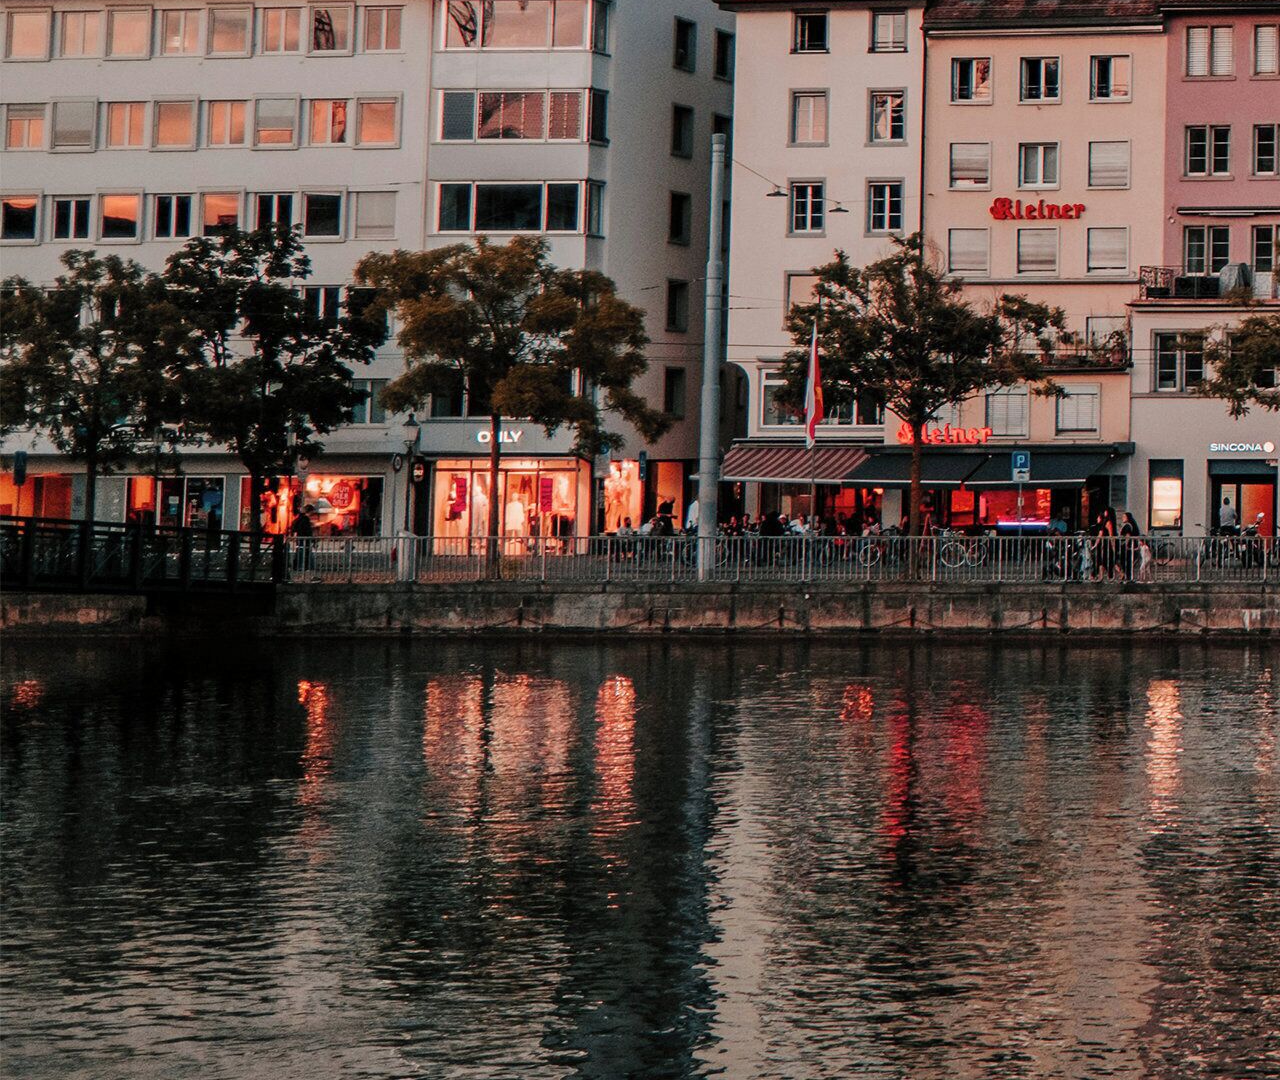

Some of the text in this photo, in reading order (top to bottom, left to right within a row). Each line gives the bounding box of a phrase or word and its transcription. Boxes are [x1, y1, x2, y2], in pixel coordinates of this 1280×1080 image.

[990, 198, 1086, 220] Kleiner
[1210, 443, 1263, 452] SINCONA
[1016, 455, 1025, 468] P
